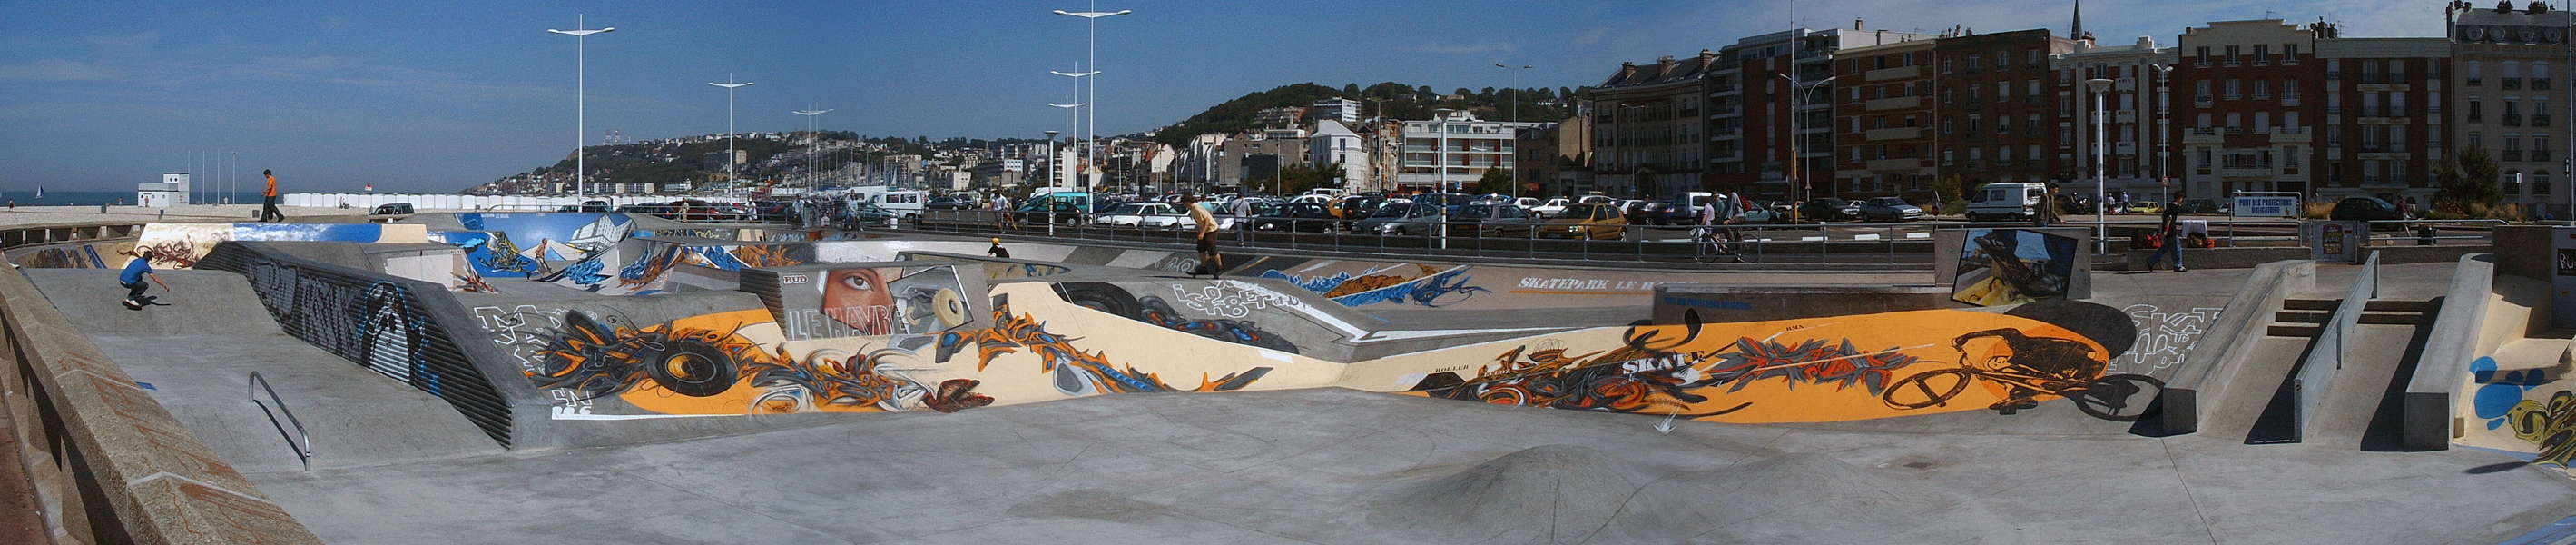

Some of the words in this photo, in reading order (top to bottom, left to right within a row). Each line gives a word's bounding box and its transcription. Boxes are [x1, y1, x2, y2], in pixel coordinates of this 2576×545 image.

[783, 273, 809, 284] BUD
[1516, 276, 1610, 290] SKATEPARK
[1614, 281, 1637, 290] LE
[789, 309, 822, 340] LE
[823, 304, 908, 338] HAVRE
[1435, 364, 1470, 373] ROLLER
[1621, 351, 1706, 375] SKATE
